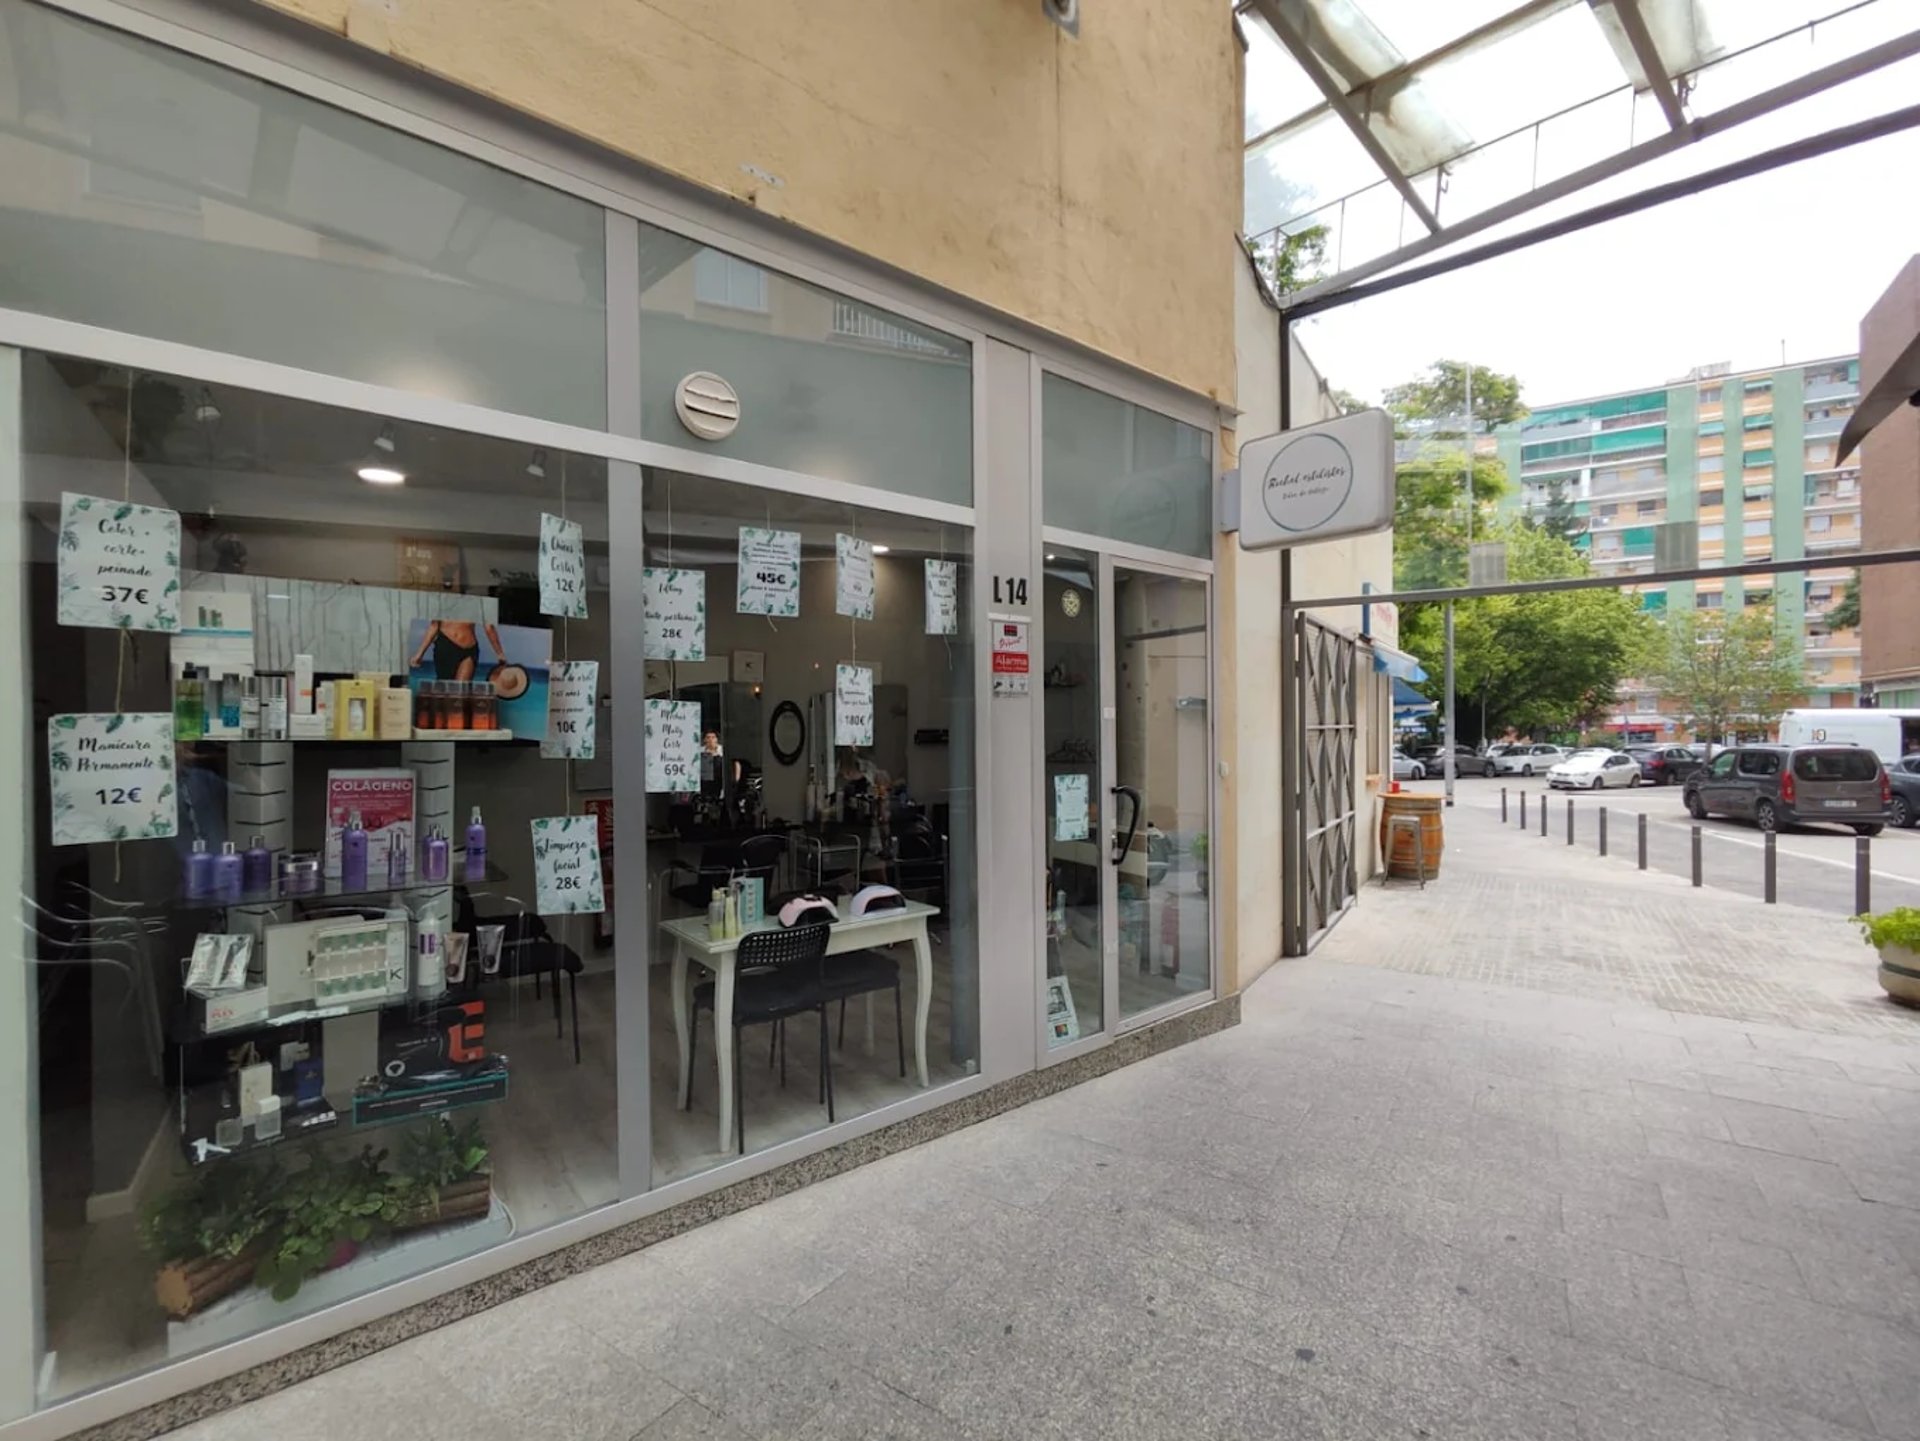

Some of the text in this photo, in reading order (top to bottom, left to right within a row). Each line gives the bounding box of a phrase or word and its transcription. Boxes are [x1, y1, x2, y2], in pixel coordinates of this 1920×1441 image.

[98, 519, 136, 536] Color
[97, 565, 152, 577] peinado
[756, 572, 786, 584] 45€
[556, 578, 575, 593] 12€
[101, 585, 149, 604] 37€
[662, 628, 682, 638] 28€
[557, 721, 576, 733] 10€
[78, 737, 151, 752] Manicura
[77, 757, 154, 772] Permanente
[664, 764, 686, 776] 69€
[95, 787, 142, 805] 12€
[544, 838, 587, 855] Limpieza
[553, 857, 580, 874] facial
[556, 876, 581, 890] 28€
